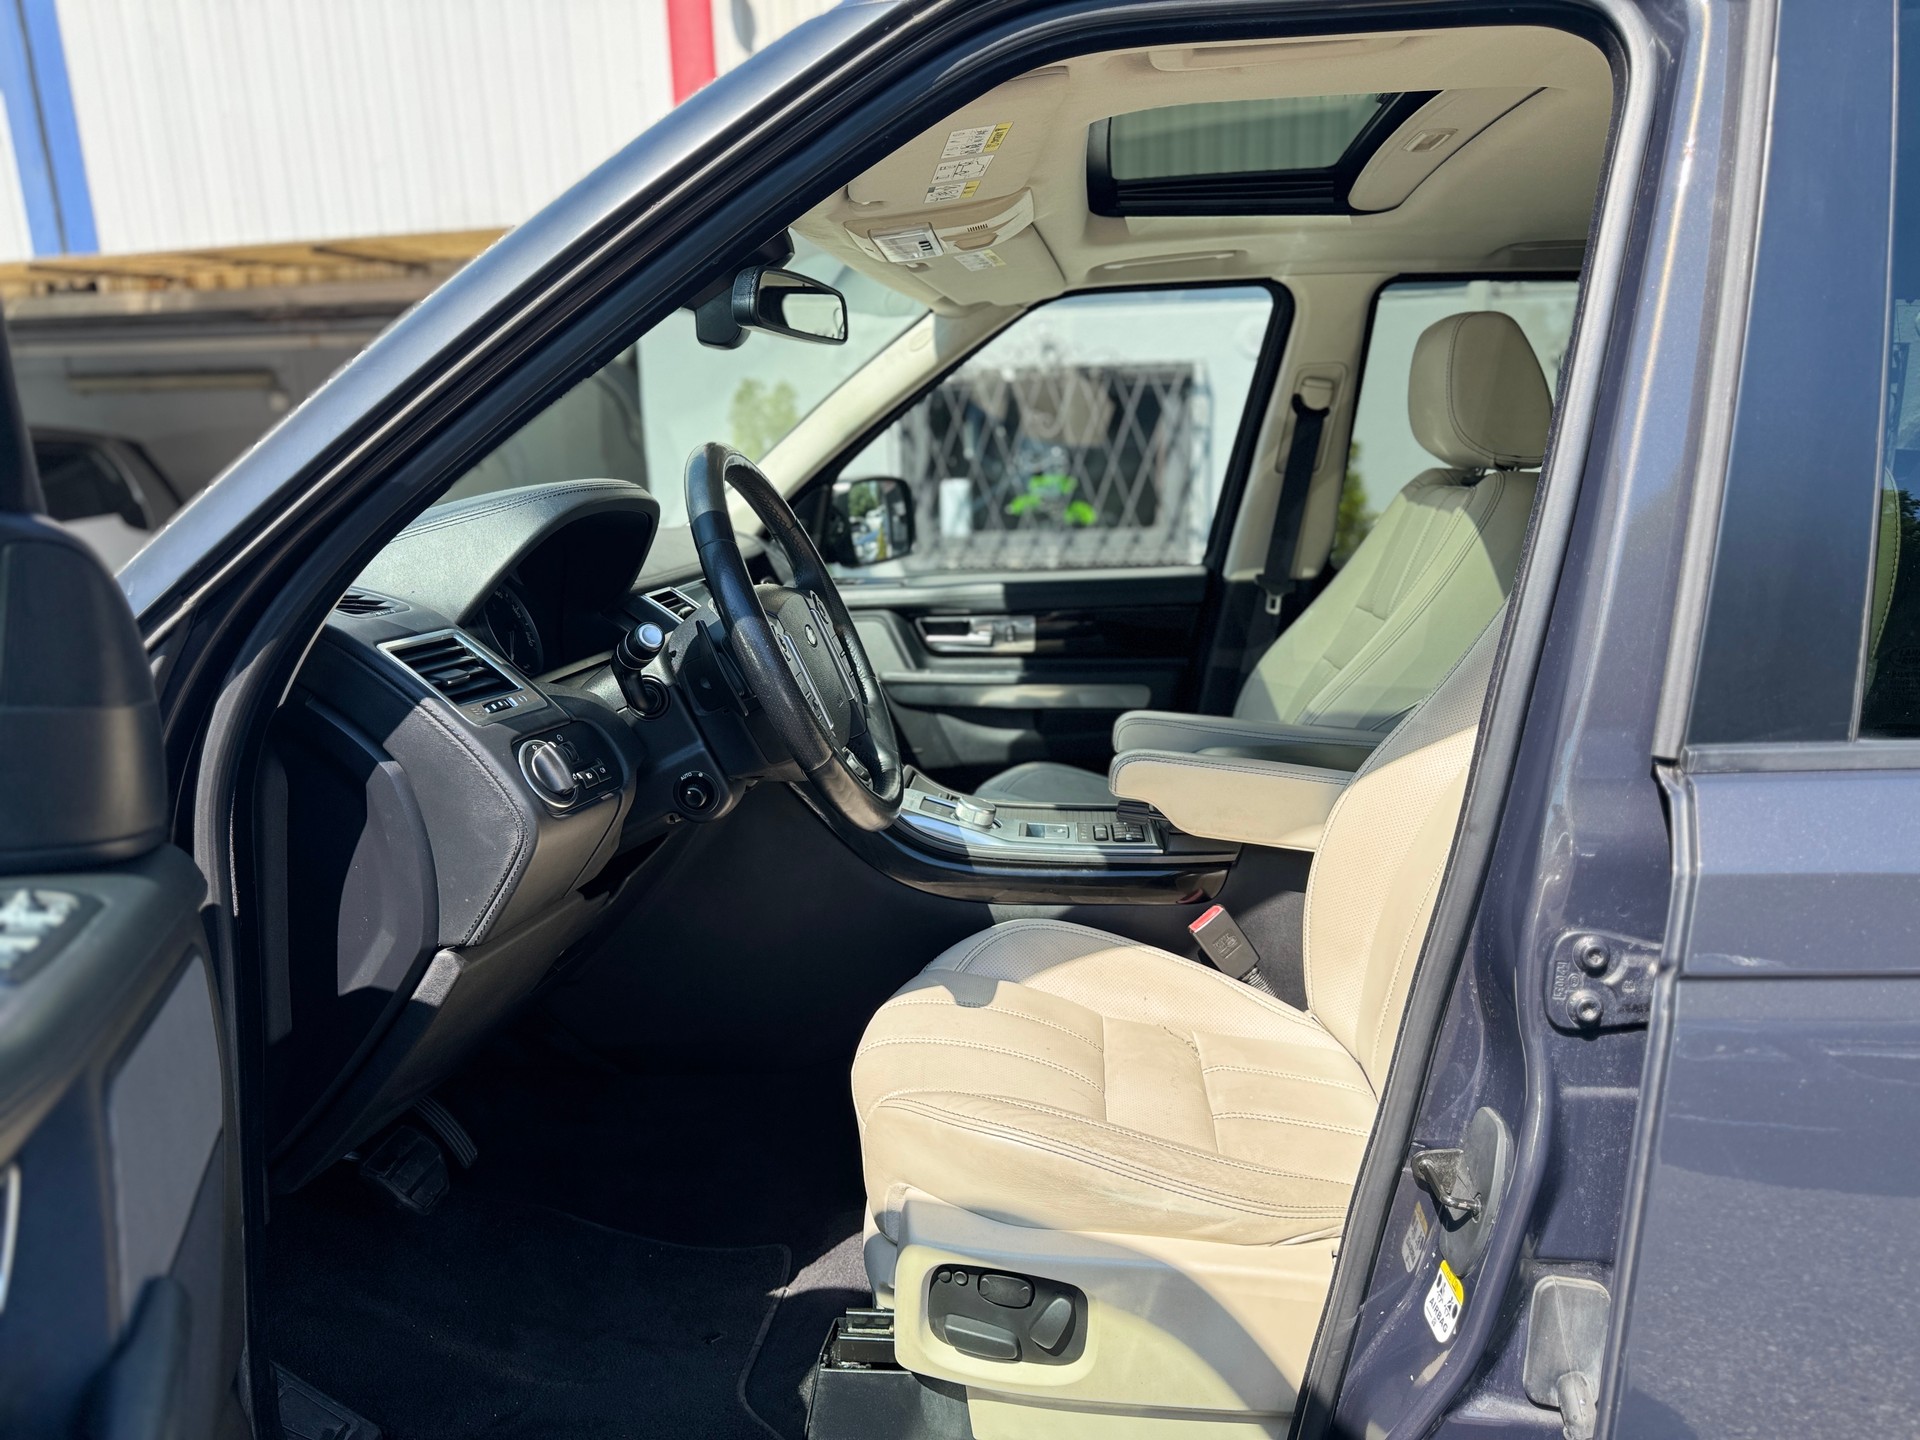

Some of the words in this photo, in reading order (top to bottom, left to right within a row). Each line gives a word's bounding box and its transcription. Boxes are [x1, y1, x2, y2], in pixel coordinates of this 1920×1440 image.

[1899, 649, 1920, 657] LAN
[680, 771, 693, 781] AUTO
[1429, 1297, 1448, 1333] AIRBAG
